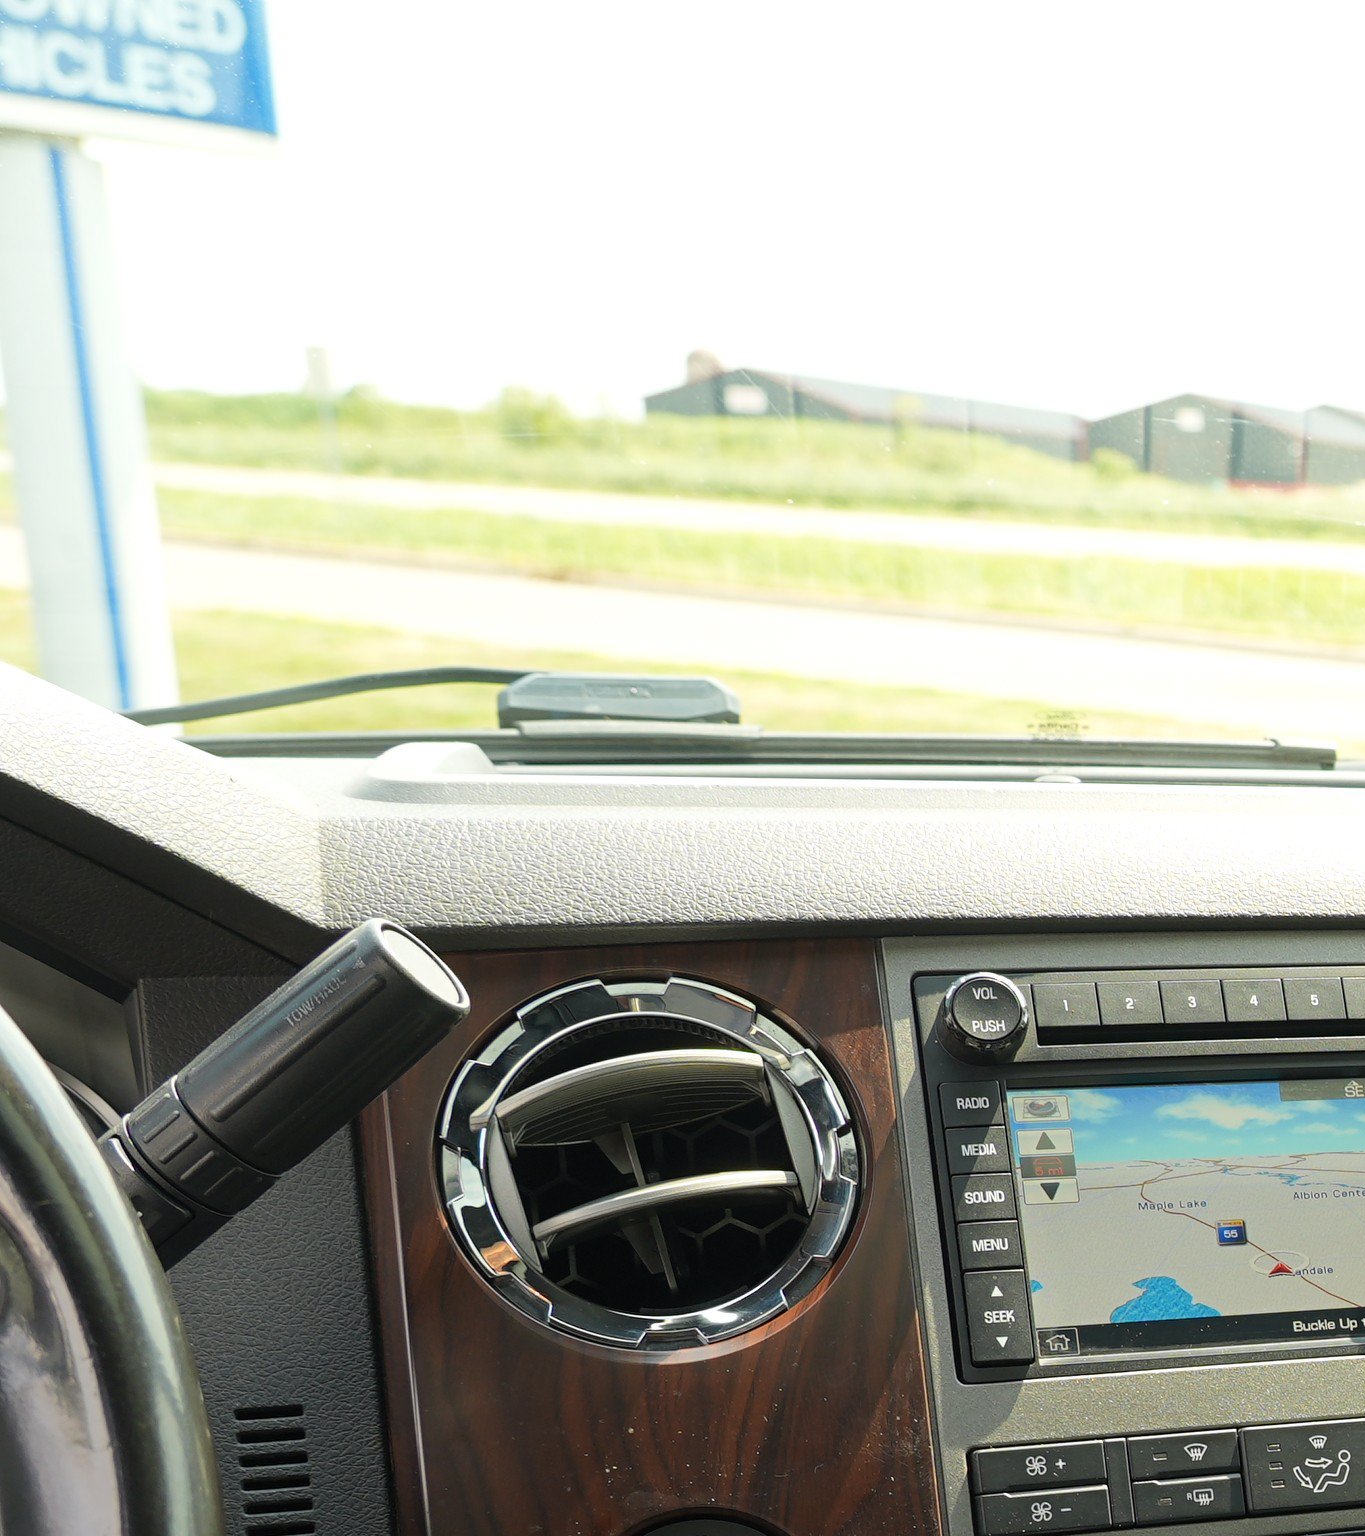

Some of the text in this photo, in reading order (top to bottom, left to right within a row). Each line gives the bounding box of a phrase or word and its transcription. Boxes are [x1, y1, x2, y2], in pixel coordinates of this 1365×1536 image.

[972, 987, 997, 1000] VOL
[1062, 1000, 1069, 1011] 1
[1125, 998, 1134, 1009] 2
[1188, 996, 1197, 1008] 3
[1250, 994, 1258, 1006] 4
[1310, 994, 1319, 1006] 5
[972, 1020, 1006, 1033] PUSH
[1344, 1084, 1364, 1097] SE
[956, 1097, 990, 1110] RADIO
[961, 1143, 997, 1156] MEDIA
[1035, 1166, 1064, 1176] 5 mi
[964, 1191, 1005, 1204] SOUND
[1293, 1189, 1328, 1200] Albion
[1138, 1199, 1207, 1212] Maple Lake
[1223, 1229, 1238, 1239] 55
[972, 1238, 1009, 1252] MENU
[1294, 1266, 1334, 1276] andale
[984, 1310, 1015, 1324] SEEK
[1293, 1319, 1336, 1332] Buckle
[1339, 1318, 1357, 1331] Up
[1186, 1493, 1192, 1501] R
